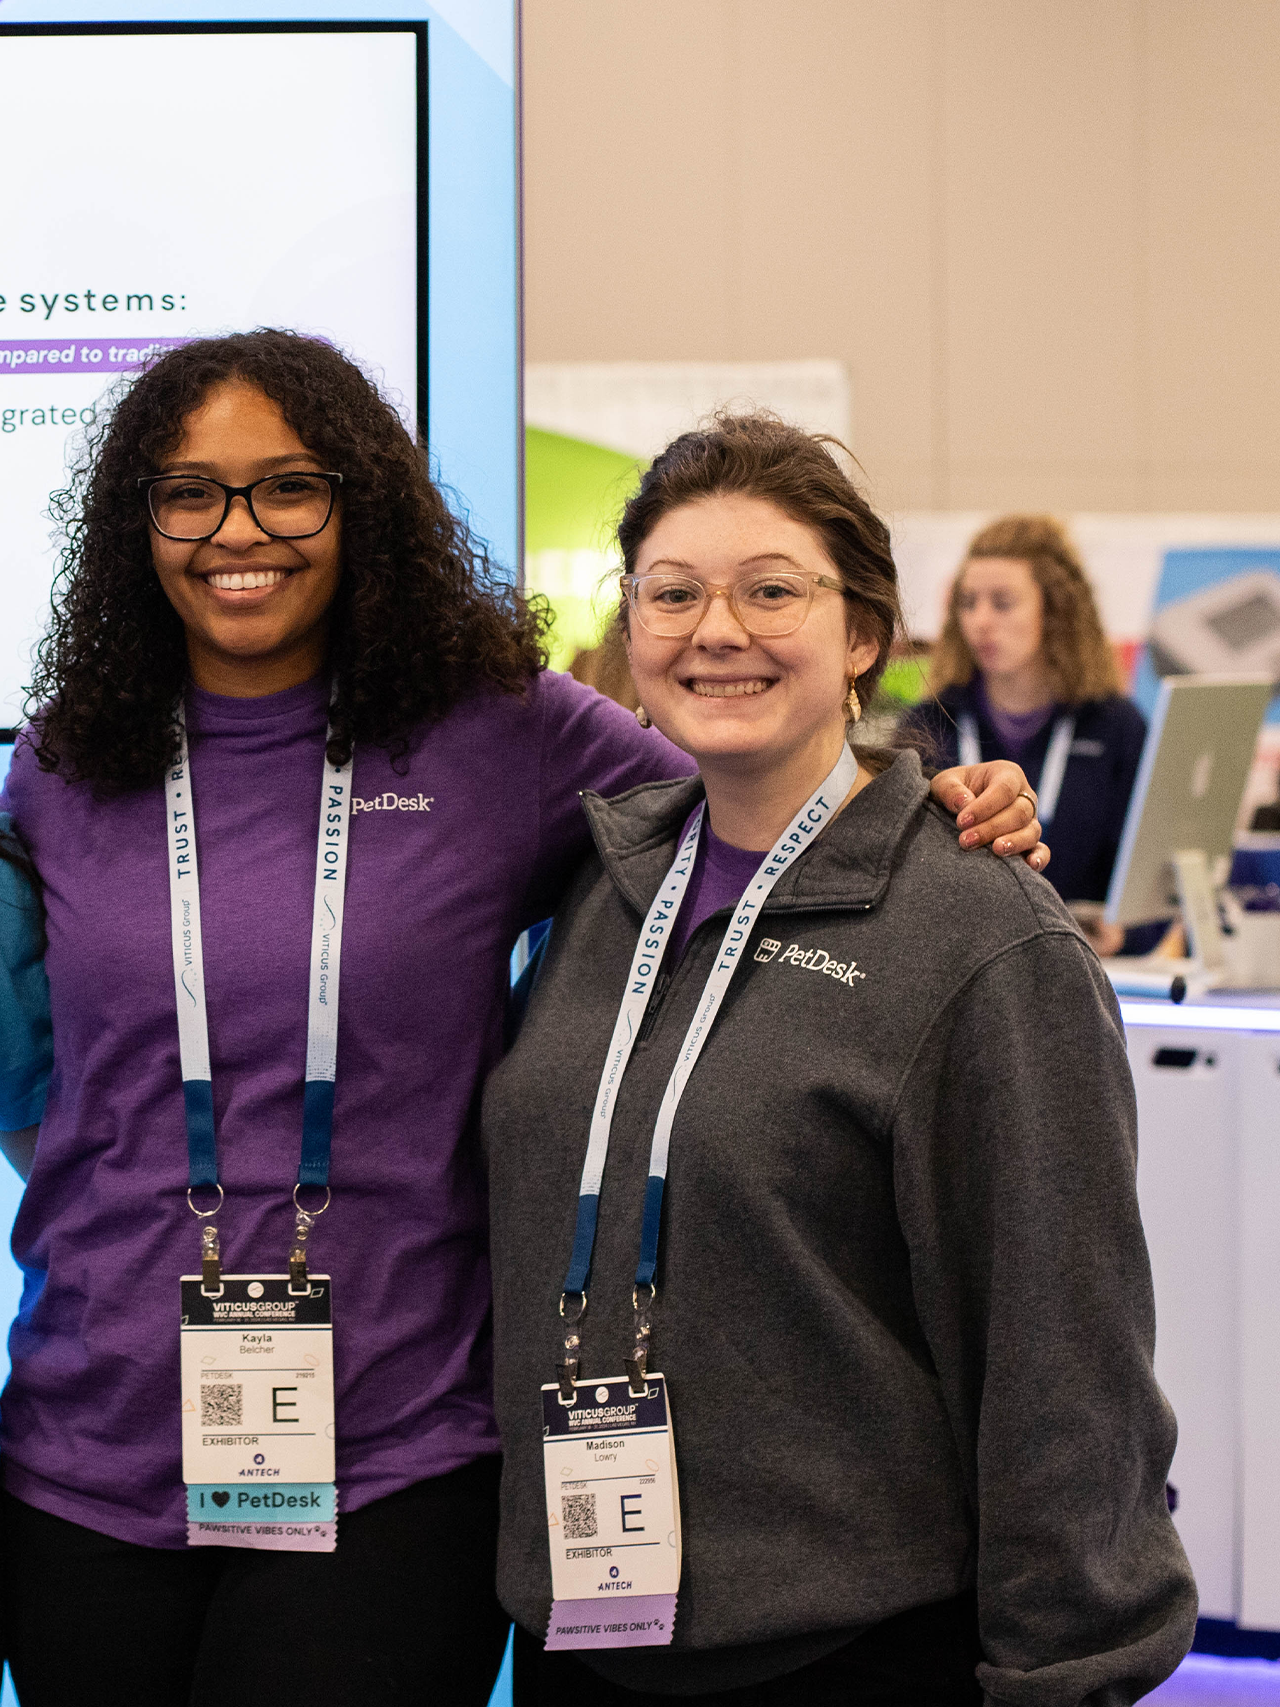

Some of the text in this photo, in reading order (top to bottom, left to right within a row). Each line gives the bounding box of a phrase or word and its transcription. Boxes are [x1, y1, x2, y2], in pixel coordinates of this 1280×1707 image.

[20, 288, 187, 320] systems:
[80, 346, 103, 363] to
[351, 792, 431, 815] PetDesk
[323, 785, 343, 881] PASSION
[764, 795, 830, 877] RESPECT
[174, 810, 191, 879] TRUST
[181, 899, 193, 967] VITICUS Group
[718, 899, 756, 972] TRUST
[632, 899, 674, 995] PASSION
[319, 933, 330, 1005] VITICUS Group
[778, 944, 862, 987] PetDesk
[684, 993, 715, 1062] VITICUS Group
[600, 1049, 624, 1119] VITICUS Group
[212, 1302, 296, 1312] VITICUSGROUP
[254, 1310, 296, 1318] CONFERENCE
[242, 1333, 272, 1345] Kayla
[239, 1345, 275, 1355] Belcher
[200, 1372, 233, 1380] PETDESK
[272, 1387, 299, 1423] E
[568, 1405, 636, 1420] VITICUSGROUP
[581, 1417, 602, 1425] ANNUAL
[602, 1414, 637, 1424] CONFERENCE
[202, 1436, 259, 1446] EXHIBITOR
[586, 1440, 625, 1450] Madison
[594, 1453, 618, 1462] Lowry
[238, 1468, 280, 1477] ANTECH
[199, 1491, 321, 1508] I PetDesk
[620, 1493, 645, 1533] E
[198, 1523, 312, 1536] PAWSITIVE VIBES ONLY
[566, 1548, 613, 1560] EXHIBITOR
[597, 1580, 633, 1591] ANTECH
[556, 1621, 653, 1635] PAWSITIVE VIBES ONLY
